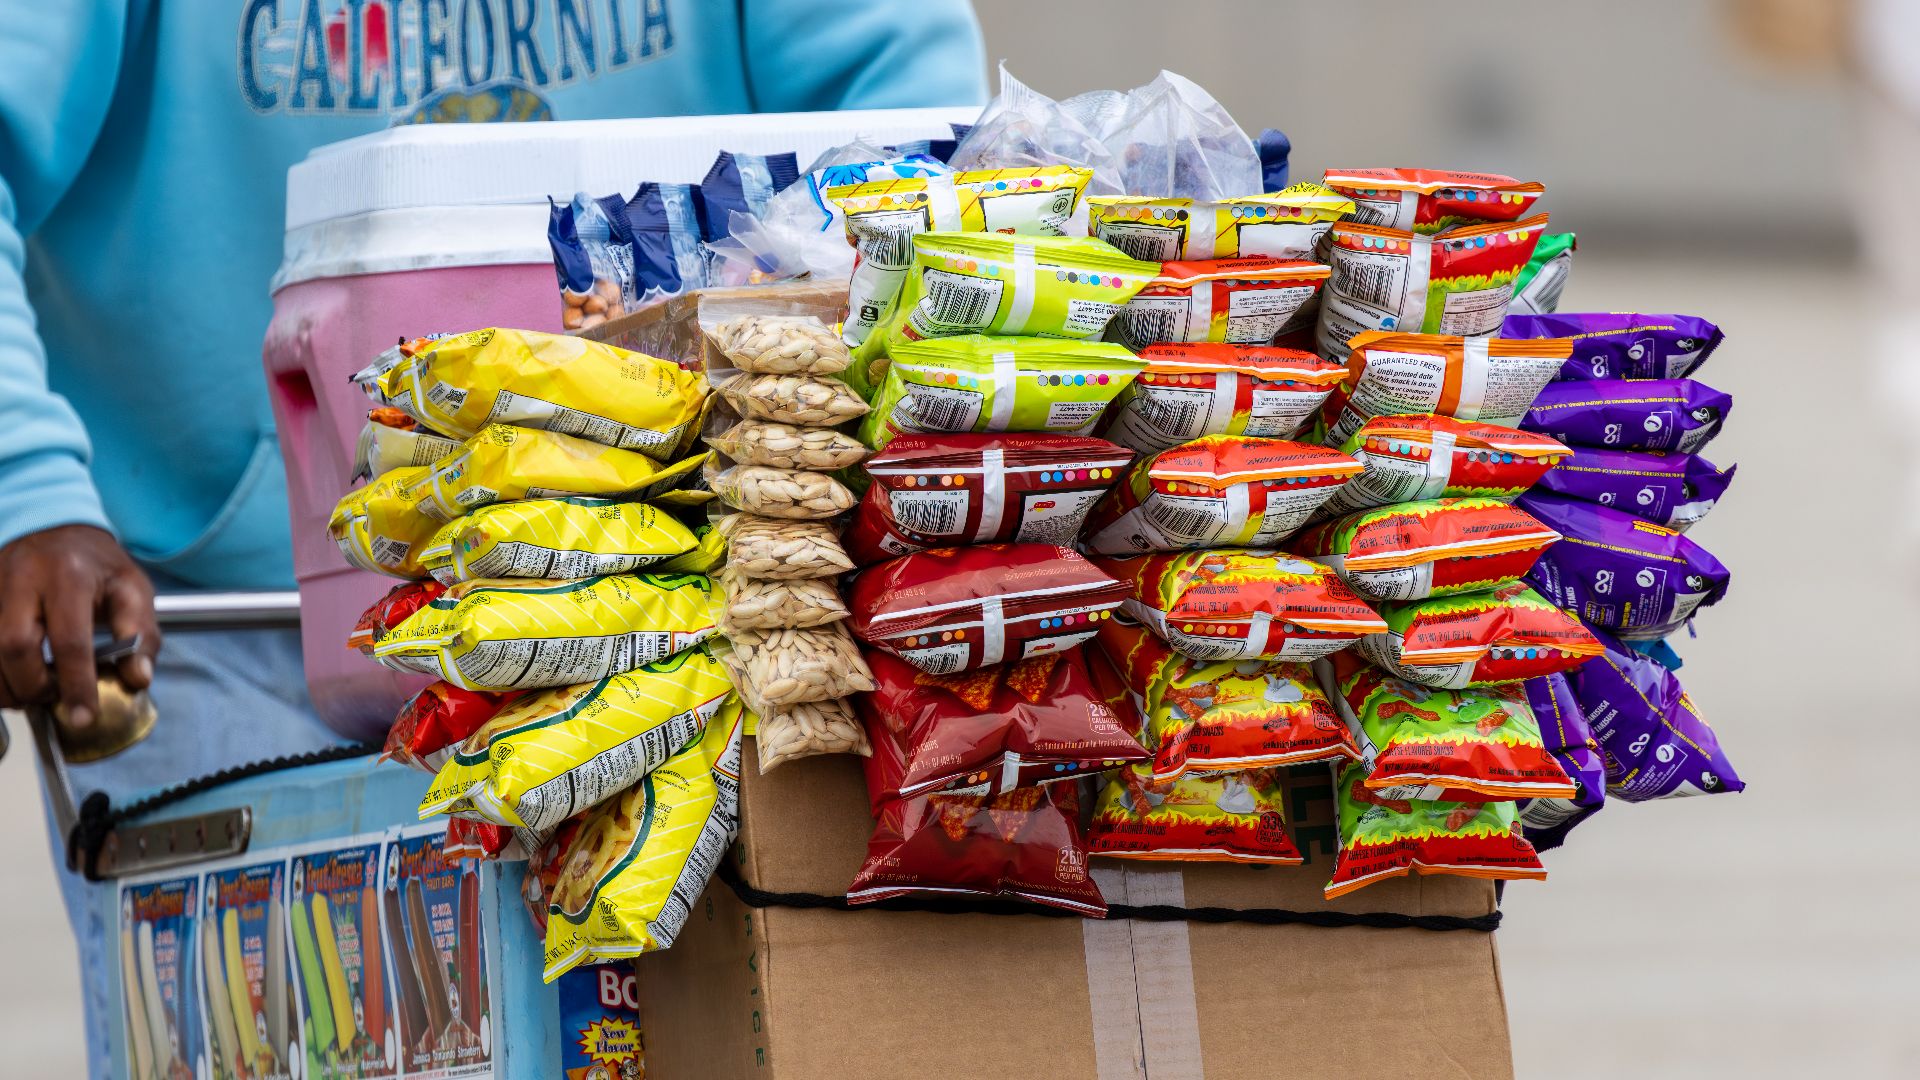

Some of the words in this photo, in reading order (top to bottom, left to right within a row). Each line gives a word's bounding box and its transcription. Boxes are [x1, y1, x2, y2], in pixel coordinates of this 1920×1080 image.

[1372, 357, 1418, 367] GUARANTEED
[1420, 361, 1442, 373] FRESH
[1376, 375, 1390, 383] this
[1391, 377, 1410, 386] snack
[1377, 367, 1393, 377] Until
[1394, 371, 1417, 380] printed
[1594, 709, 1619, 733] TAKISUSA
[643, 731, 657, 768] Calories
[1060, 849, 1082, 865] 260
[1351, 866, 1361, 876] NET
[738, 843, 764, 1067] SRVICE
[601, 1026, 627, 1039] New
[595, 1041, 634, 1054] Flavor
